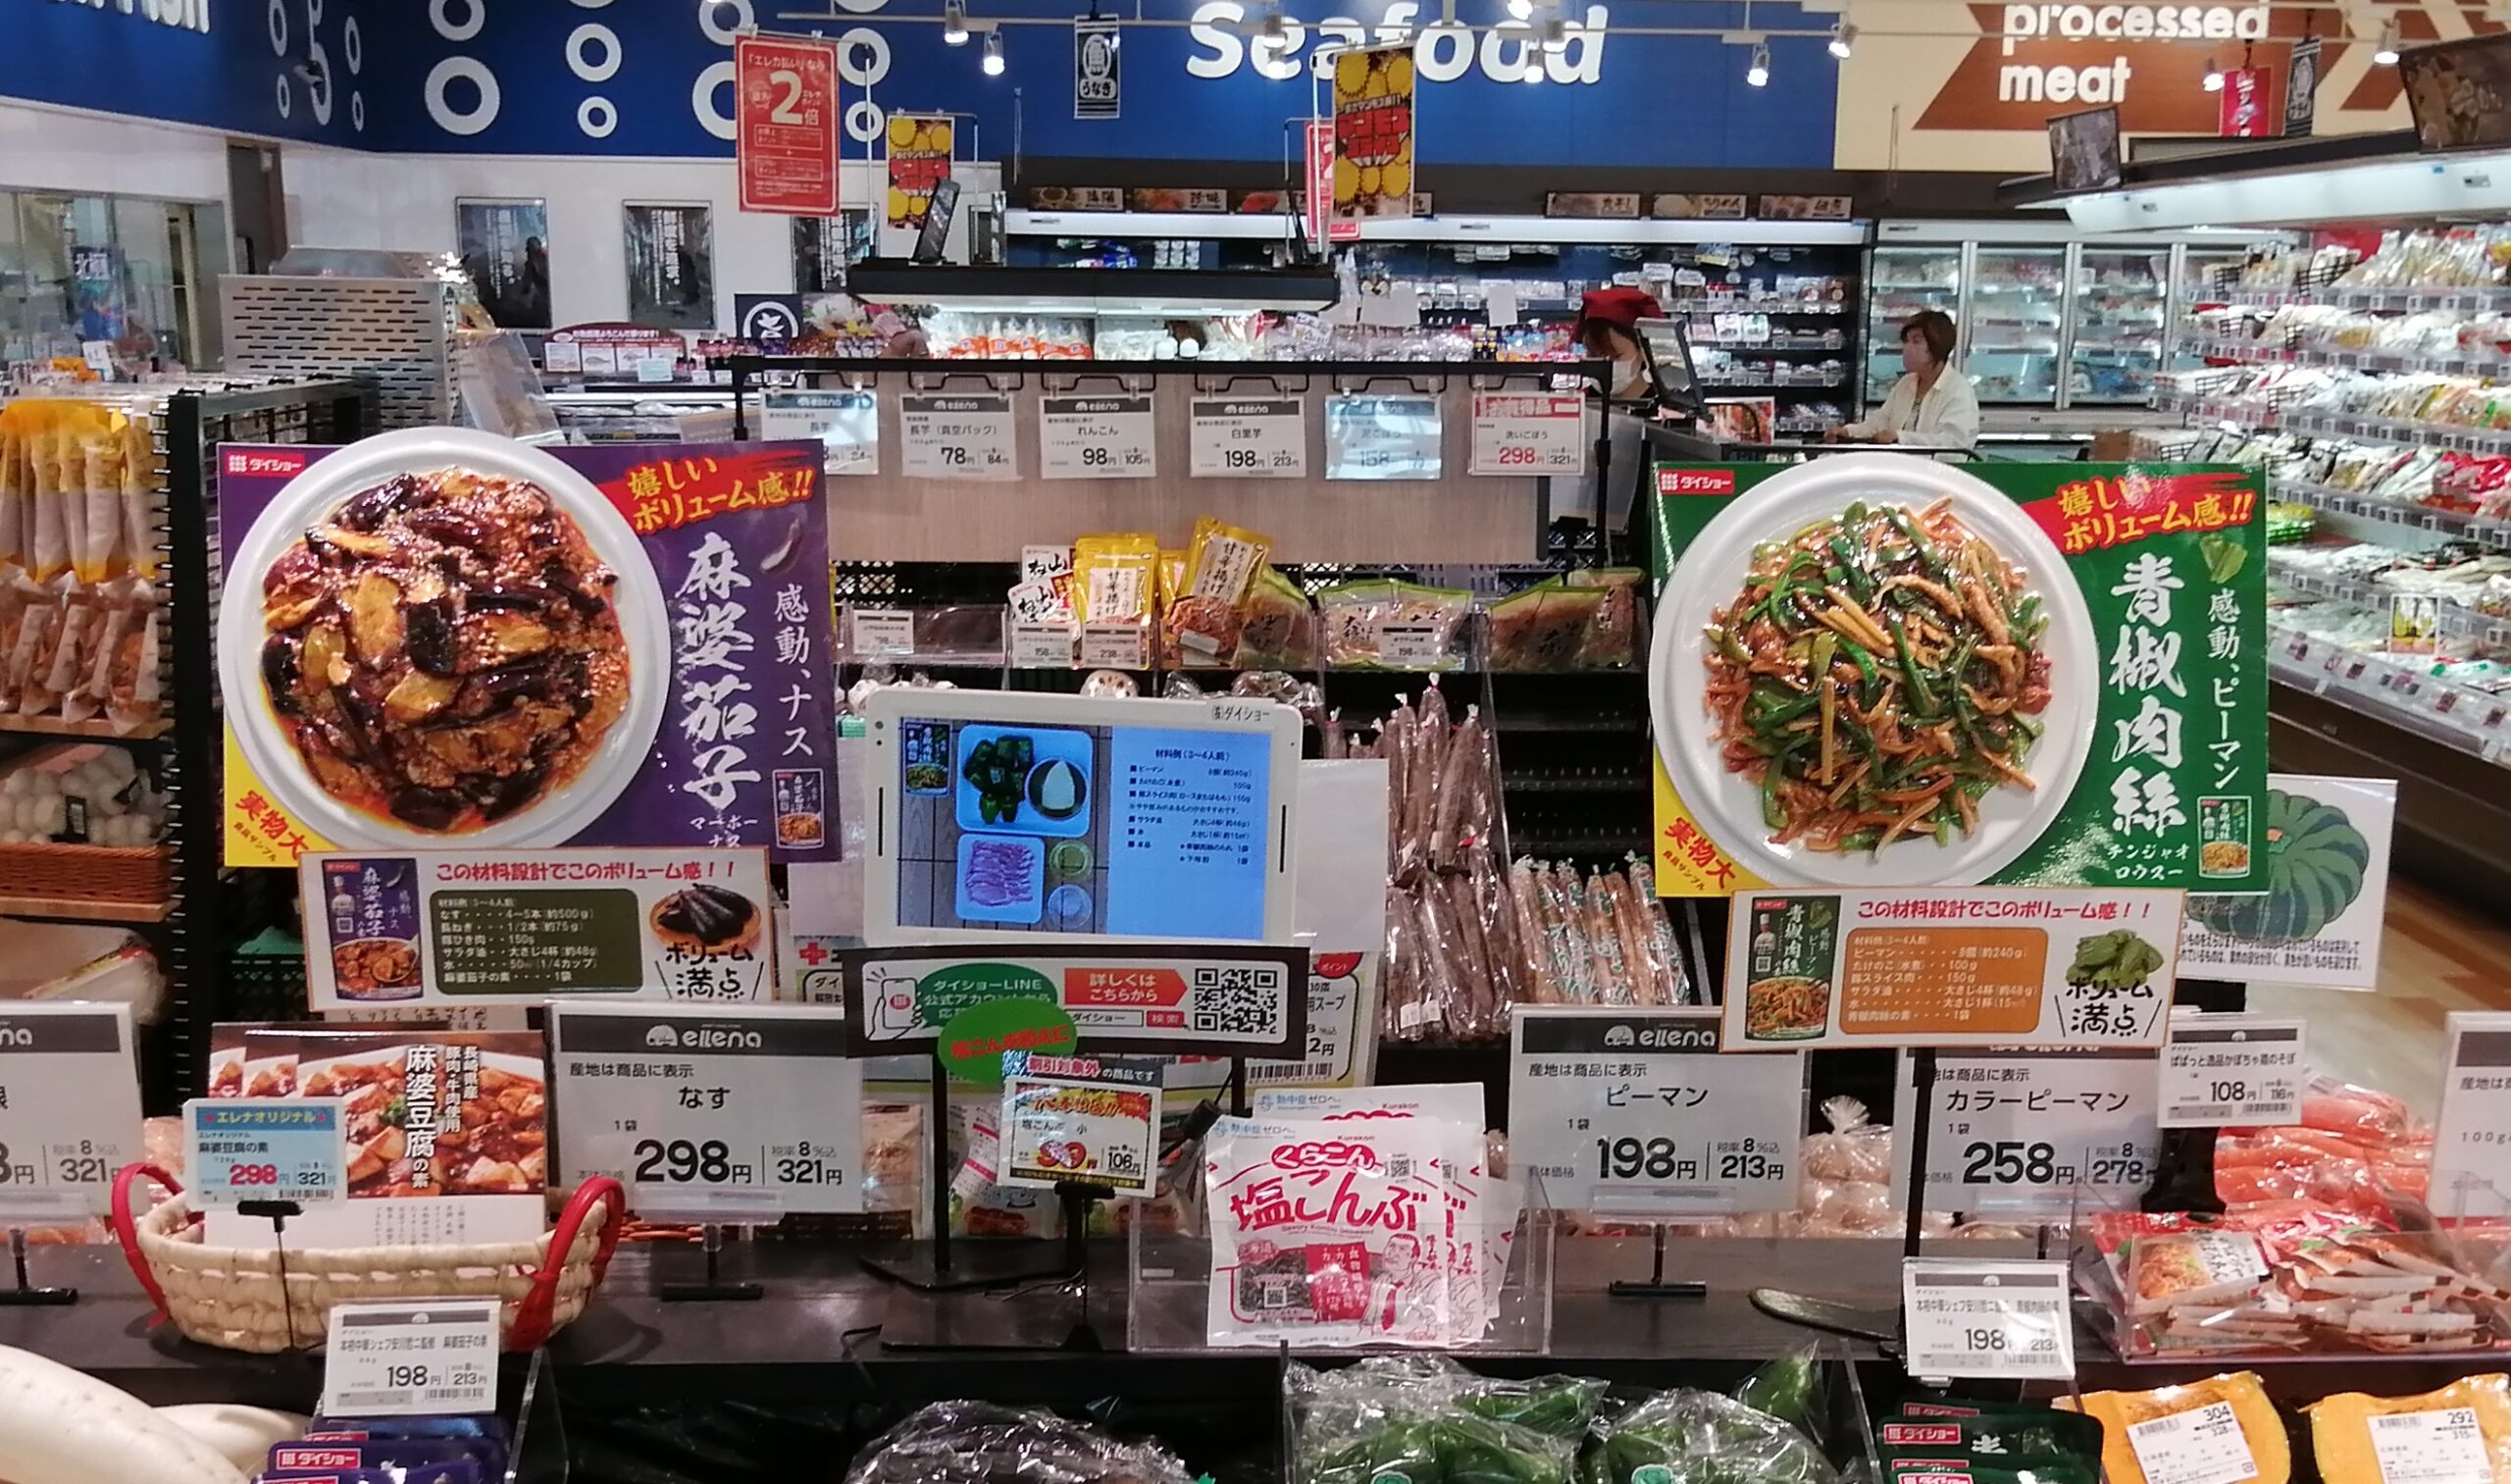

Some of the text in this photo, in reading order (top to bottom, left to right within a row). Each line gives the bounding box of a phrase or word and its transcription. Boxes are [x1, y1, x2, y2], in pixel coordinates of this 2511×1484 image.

[2002, 0, 2270, 56] processed
[1186, 2, 1609, 84] Seafood
[1082, 80, 1112, 96] うなぎ
[1999, 56, 2131, 103] meat
[769, 70, 803, 125] 2
[804, 109, 819, 126] 倍
[1077, 425, 1119, 436] れんこん
[249, 457, 302, 472] ダイショー
[628, 457, 718, 501] 嬉しい
[1680, 477, 1731, 489] ダイショー
[2060, 478, 2153, 519] 嬉しい
[675, 532, 762, 810] 麻婆茄子
[2108, 552, 2187, 839] 青椒肉絲
[235, 789, 310, 860] 実物大
[1665, 815, 1737, 890] 実物大
[666, 945, 754, 966] ボリューム
[676, 967, 744, 998] 満点
[1089, 973, 1156, 988] 詳しくは
[1090, 988, 1158, 1001] こちらから
[1150, 1012, 1179, 1024] 検索
[2071, 1003, 2139, 1037] 満点
[682, 1028, 762, 1049] ellena
[1638, 1027, 1717, 1049] ellena
[570, 1062, 694, 1078] 産地は商品に表示
[1528, 1062, 1648, 1078] 産地は商品に表示
[678, 1086, 731, 1109] なす
[1606, 1083, 1709, 1107] ピーマン
[1946, 1088, 2129, 1113] カラーピーマン
[217, 1111, 316, 1124] エレナオリジナル
[405, 1045, 437, 1189] 麻婆豆腐の素
[634, 1139, 752, 1185] 298円
[1273, 1143, 1375, 1170] くらこん
[1597, 1137, 1697, 1181] 198円
[1719, 1154, 1784, 1181] 213円
[1963, 1142, 2075, 1185] 258円
[777, 1158, 843, 1186] 321円
[1230, 1170, 1427, 1232] 塩こんぶ
[2203, 1405, 2231, 1421] 304
[2446, 1410, 2475, 1424] 292
[1904, 1427, 1956, 1441] ダイショー
[298, 1453, 355, 1467] ダイショー
